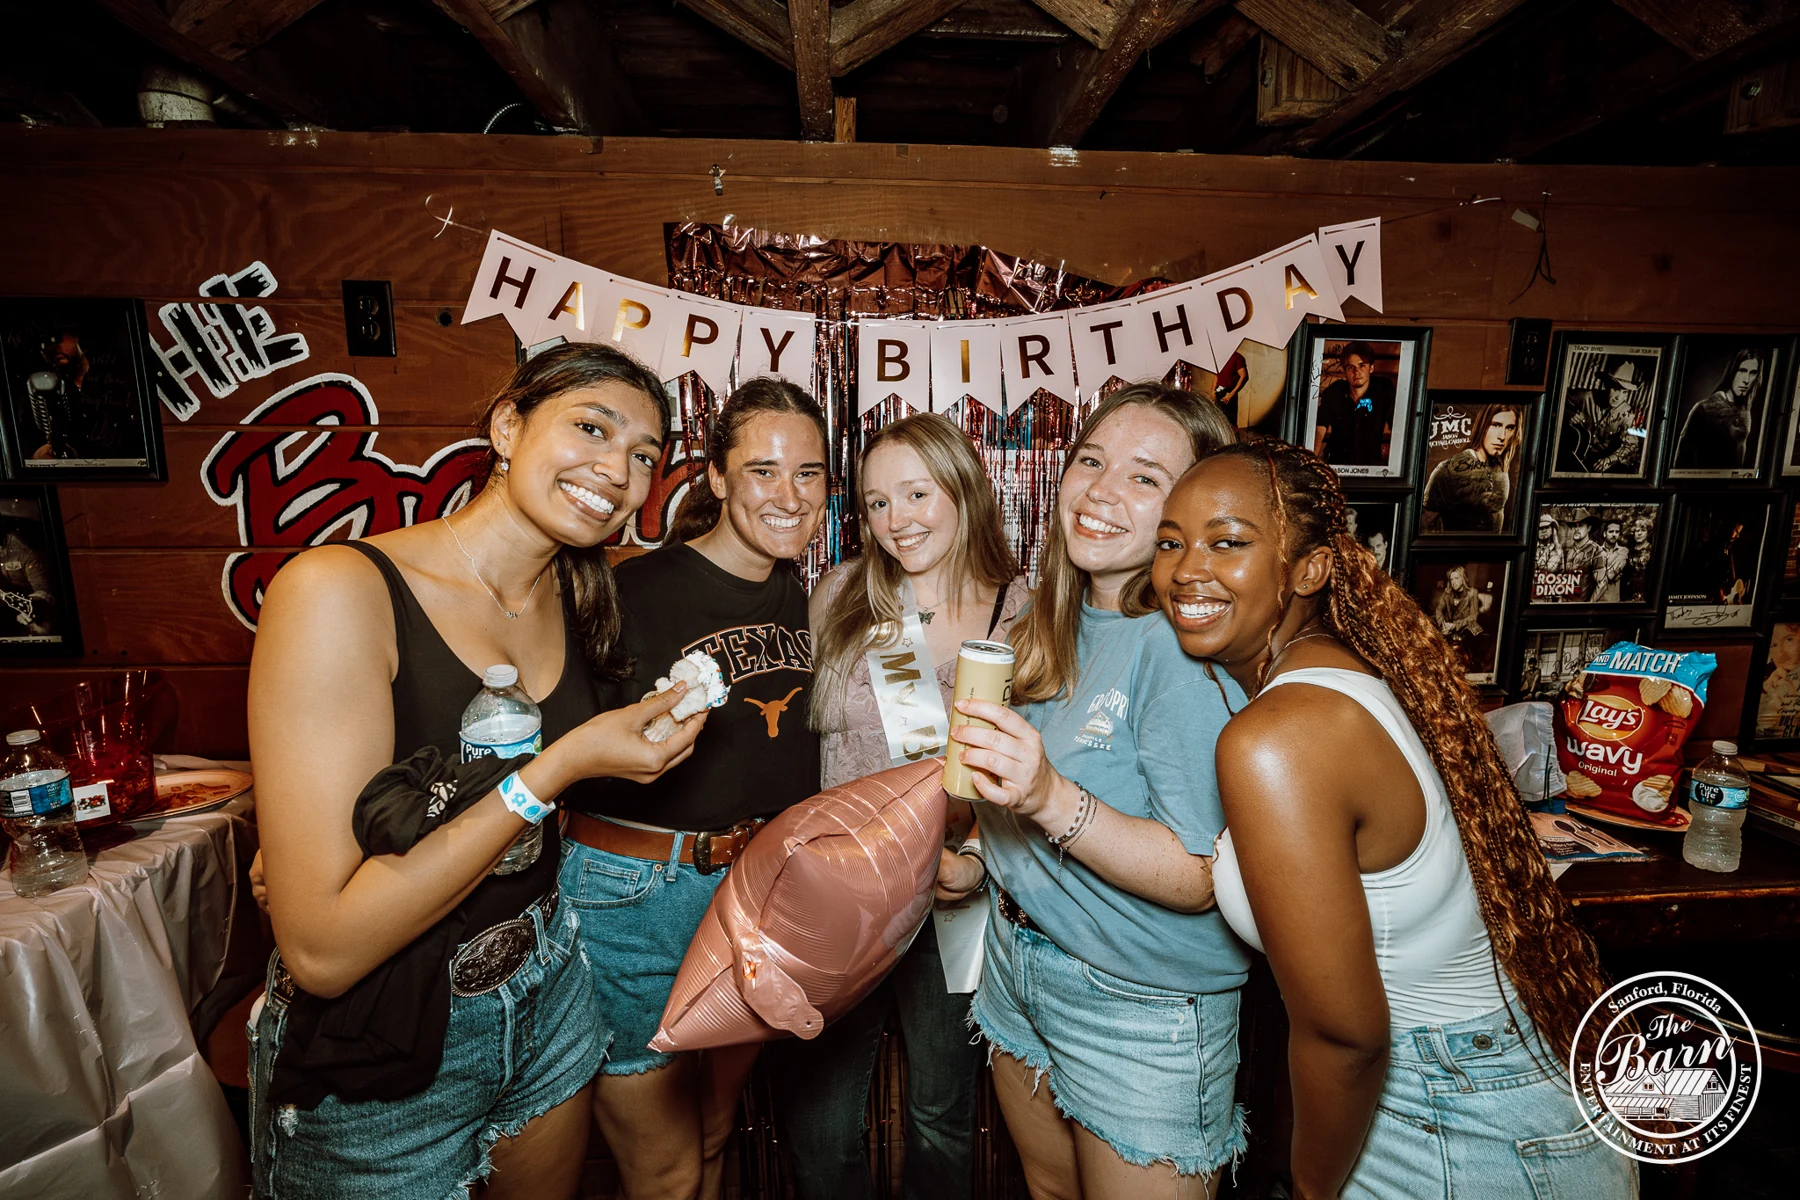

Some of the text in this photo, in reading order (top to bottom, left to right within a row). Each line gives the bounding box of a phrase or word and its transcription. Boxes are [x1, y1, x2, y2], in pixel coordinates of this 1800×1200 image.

[489, 256, 795, 373] HAPPY
[876, 240, 1365, 383] BIRTHDAY
[1429, 417, 1472, 440] JMC
[1535, 573, 1582, 586] ROSSIN
[1536, 584, 1575, 596] DIXON
[1594, 651, 1680, 674] AND MATCH
[1580, 700, 1640, 730] Lay's
[465, 743, 492, 757] Pure
[901, 724, 940, 761] B
[1566, 736, 1643, 775] wavy
[1578, 761, 1618, 777] Original
[1699, 782, 1720, 794] Pure
[1700, 789, 1716, 799] Life
